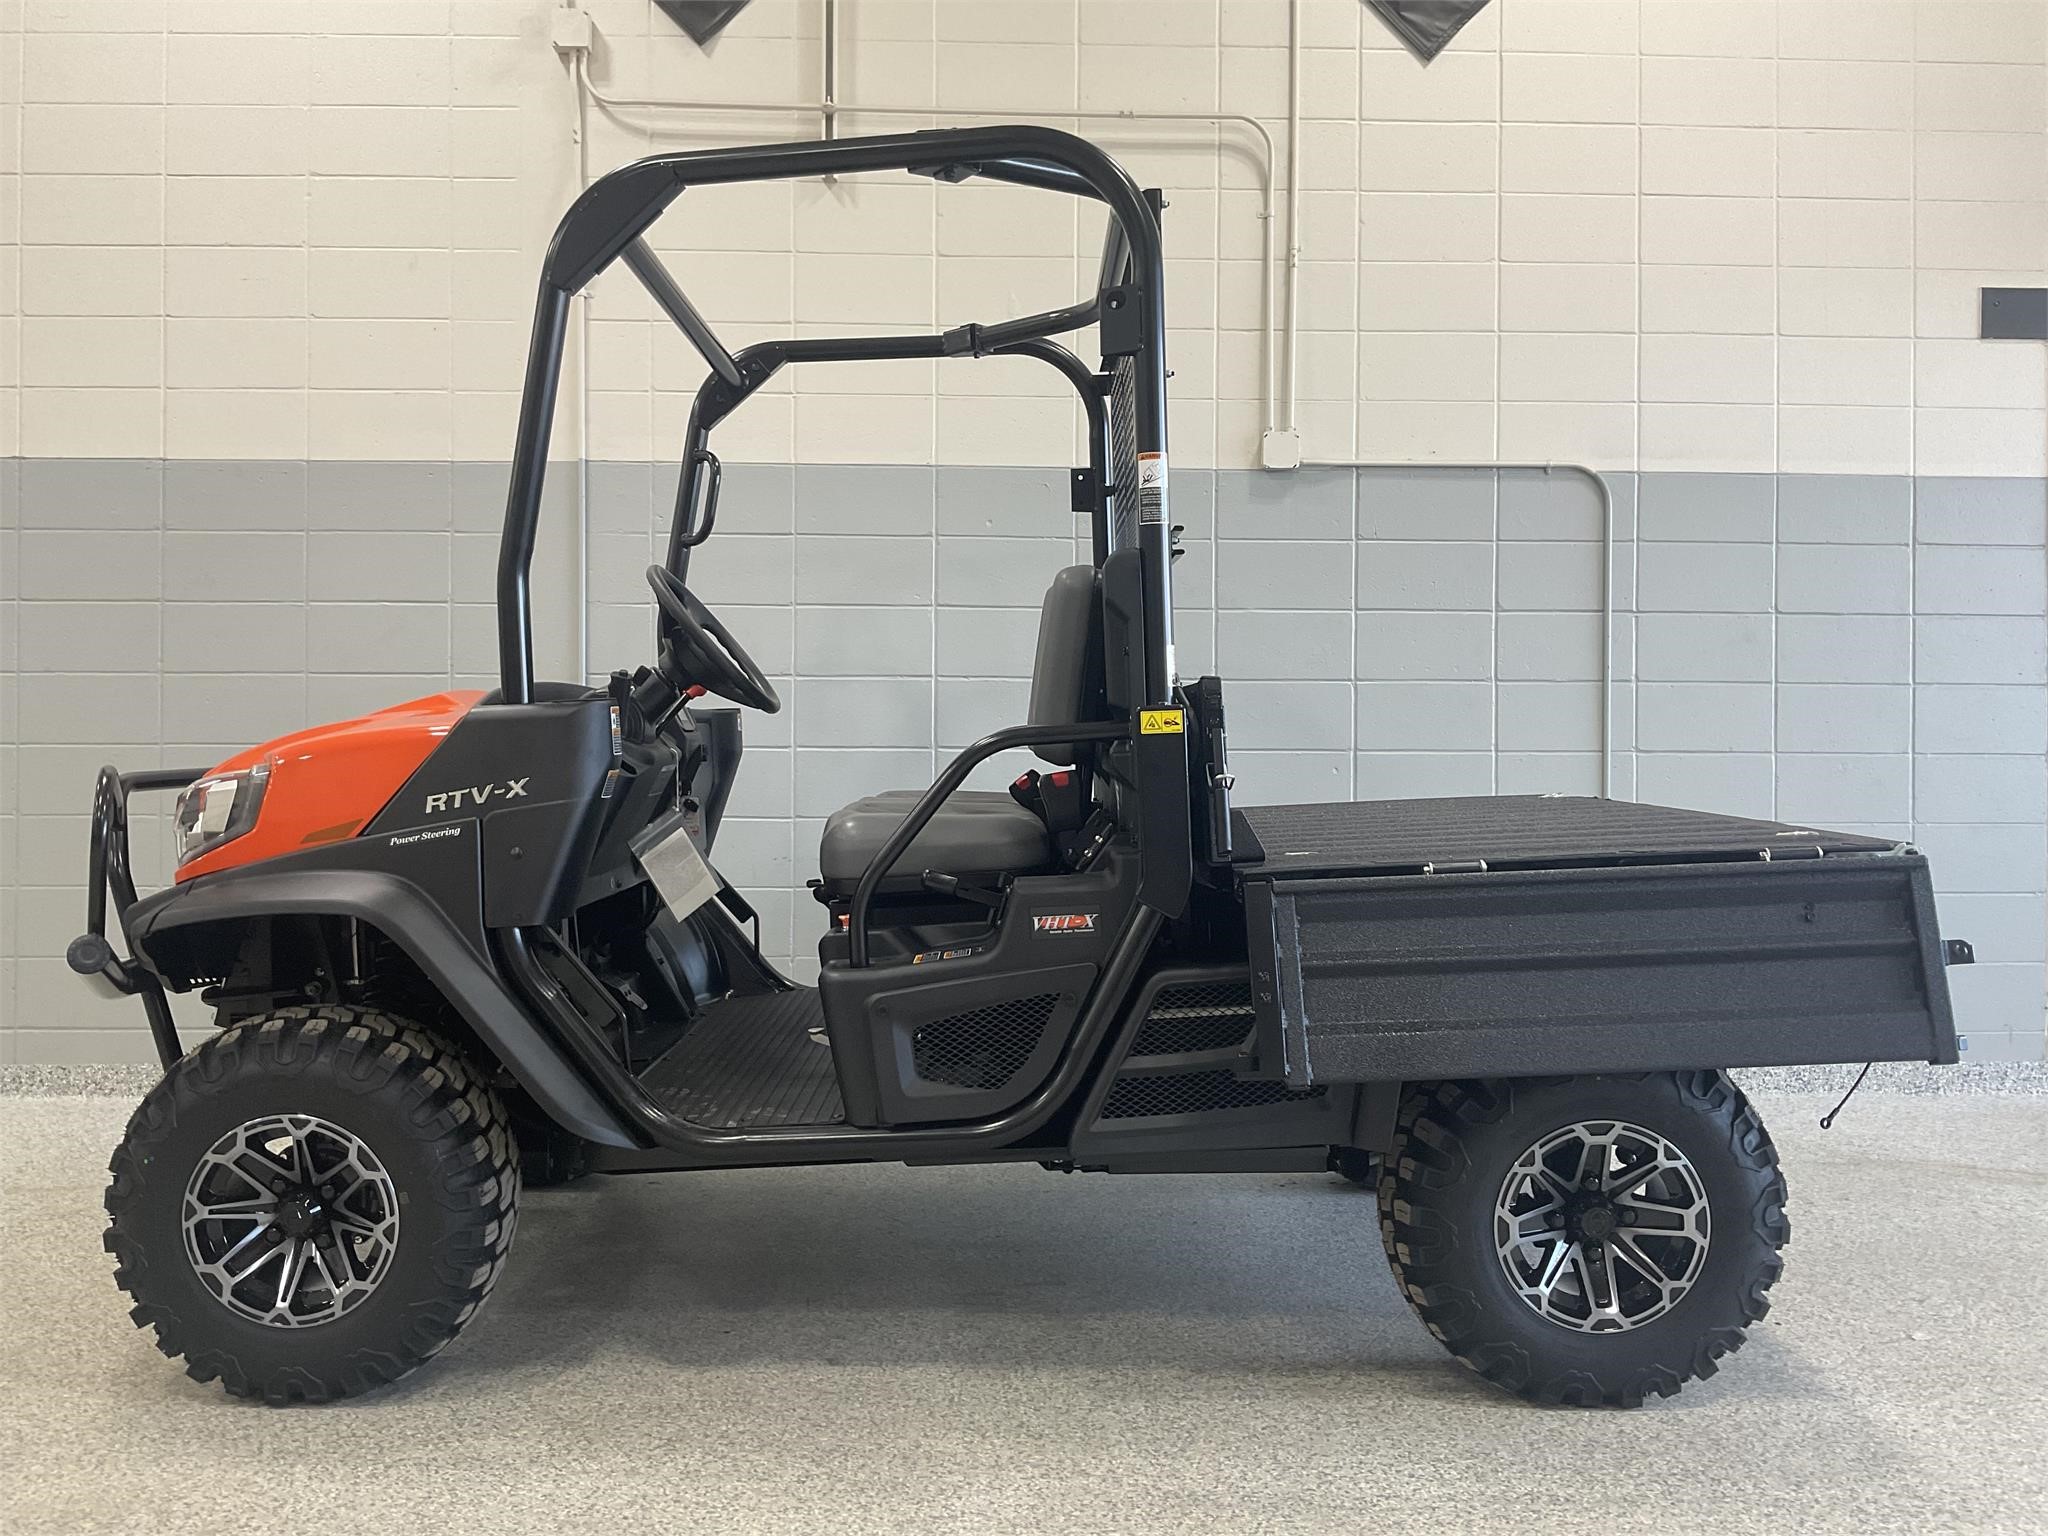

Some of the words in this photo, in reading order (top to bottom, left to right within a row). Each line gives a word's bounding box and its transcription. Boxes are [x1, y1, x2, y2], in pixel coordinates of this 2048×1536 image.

[425, 777, 530, 814] RTV-X
[390, 834, 420, 846] Power
[421, 827, 461, 841] Steering
[1032, 914, 1099, 932] VHT-X
